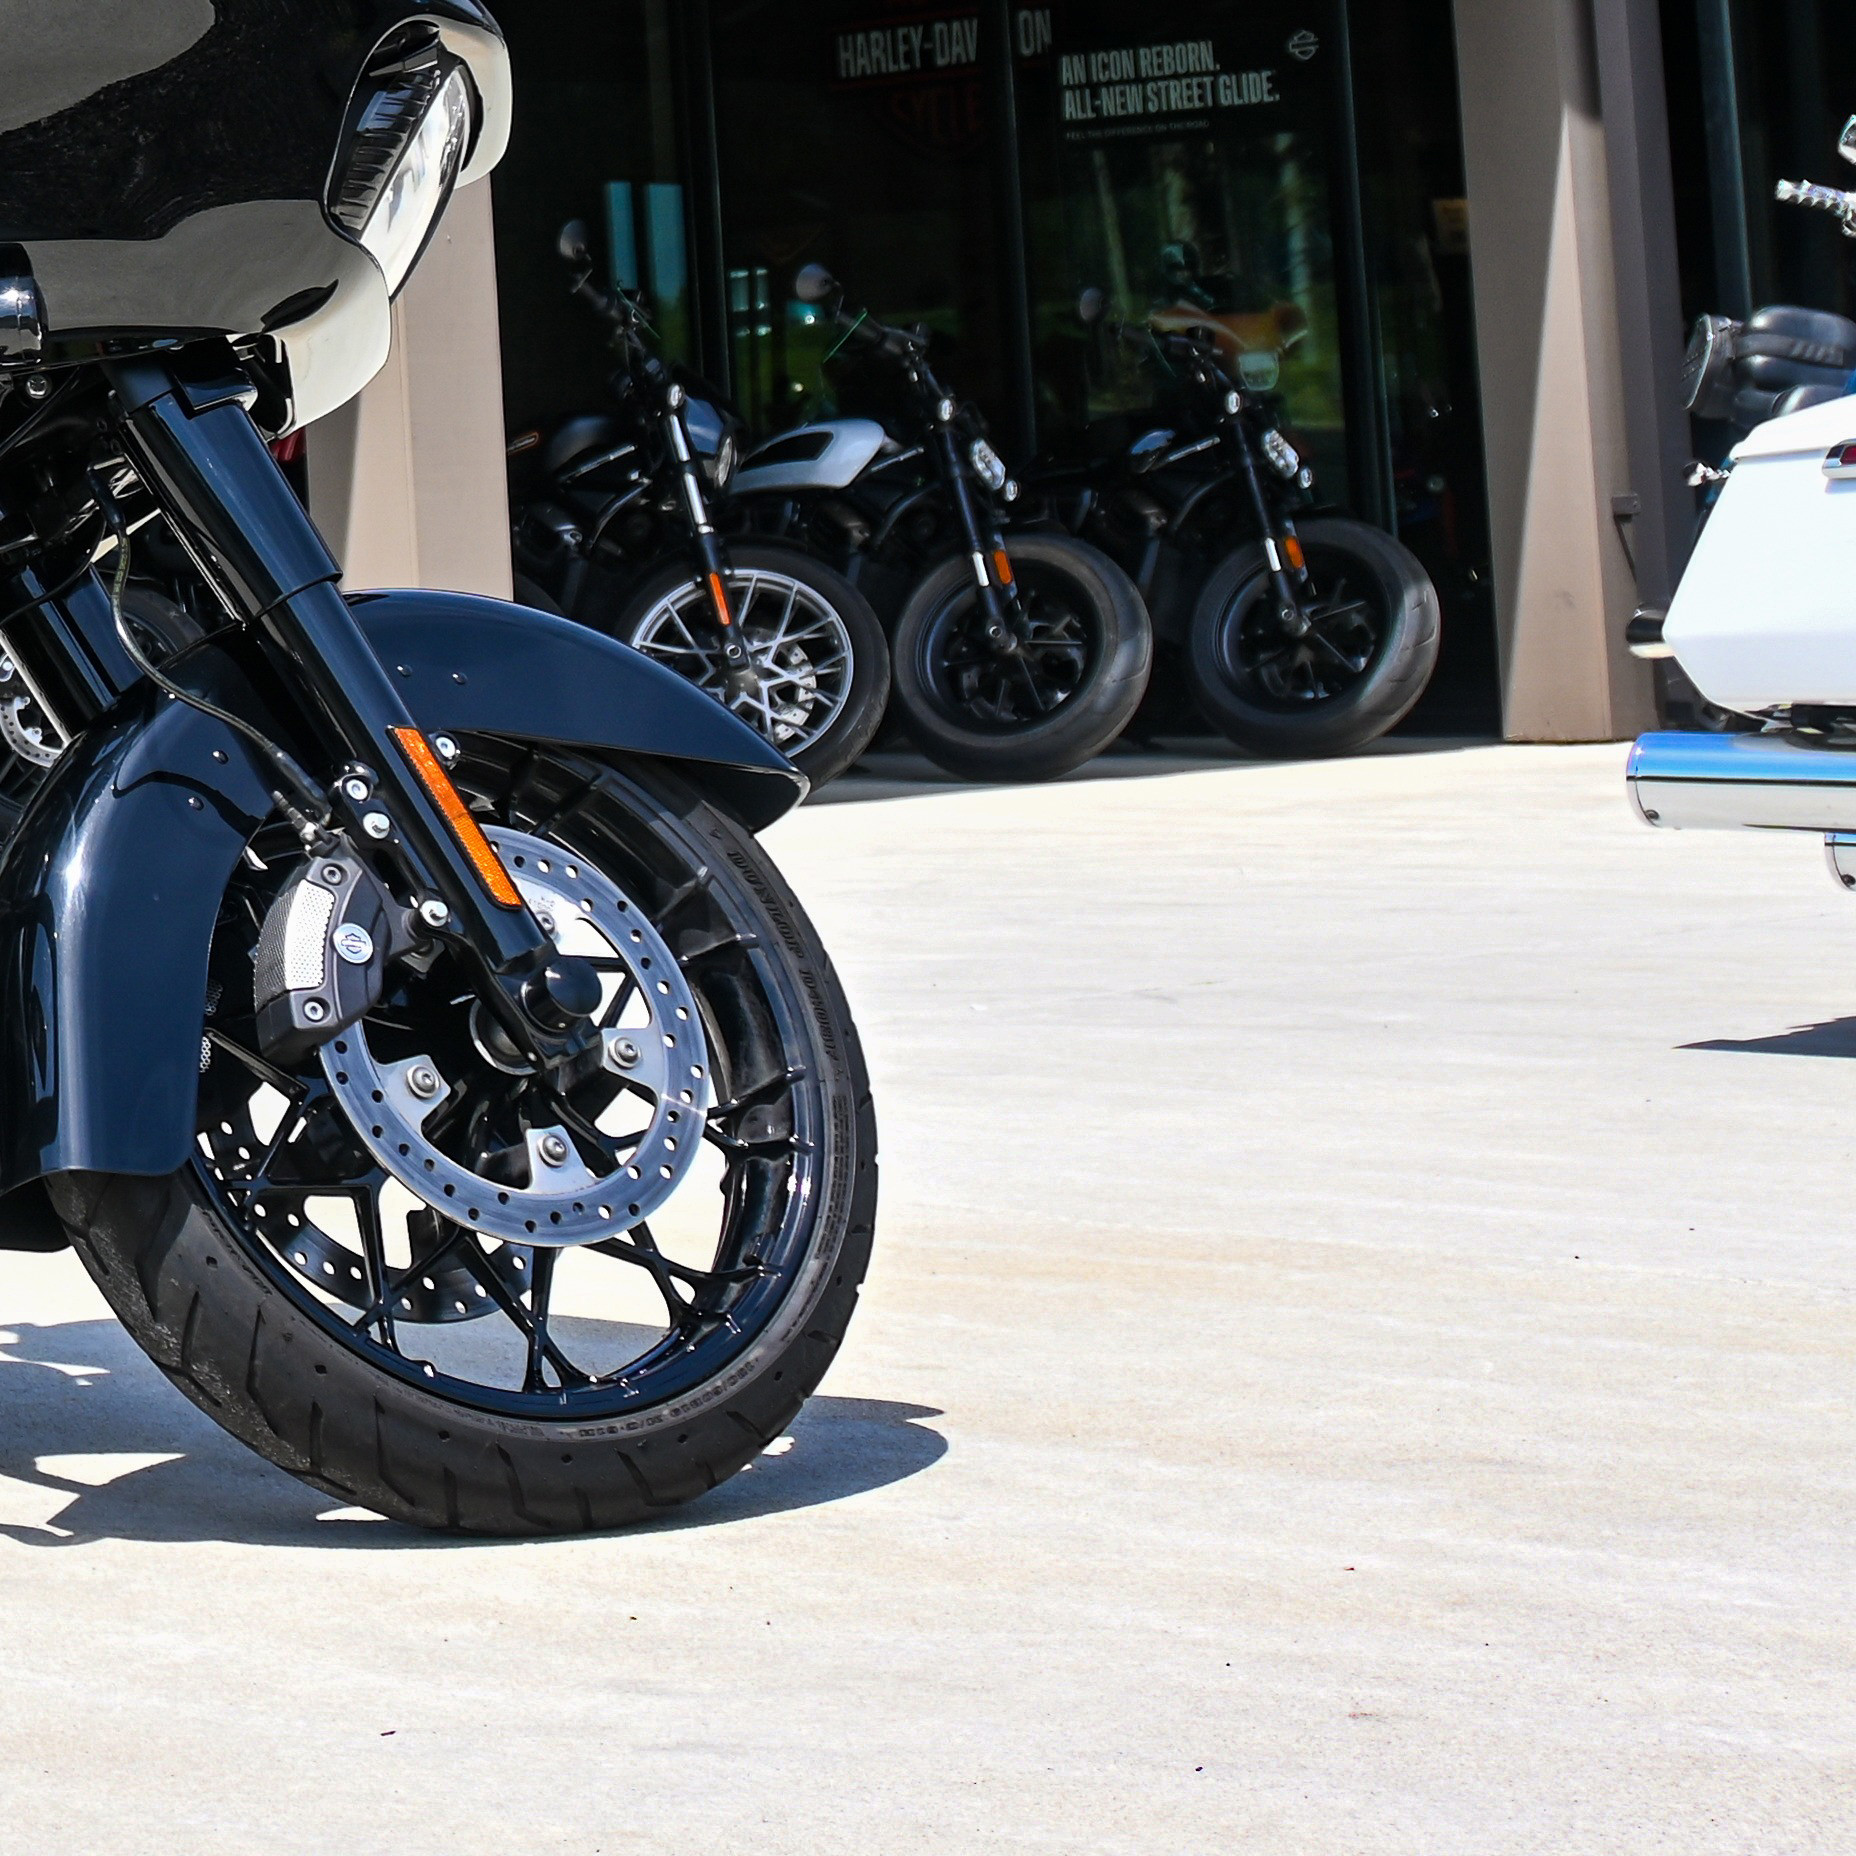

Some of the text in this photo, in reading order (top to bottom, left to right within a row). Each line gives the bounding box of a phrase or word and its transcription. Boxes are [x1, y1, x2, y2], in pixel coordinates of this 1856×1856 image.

[837, 7, 1053, 80] HARLEY-DAVON
[1062, 40, 1221, 86] AN ICON REBORN.
[1064, 69, 1281, 121] ALL-NEW STREET GLIDE.
